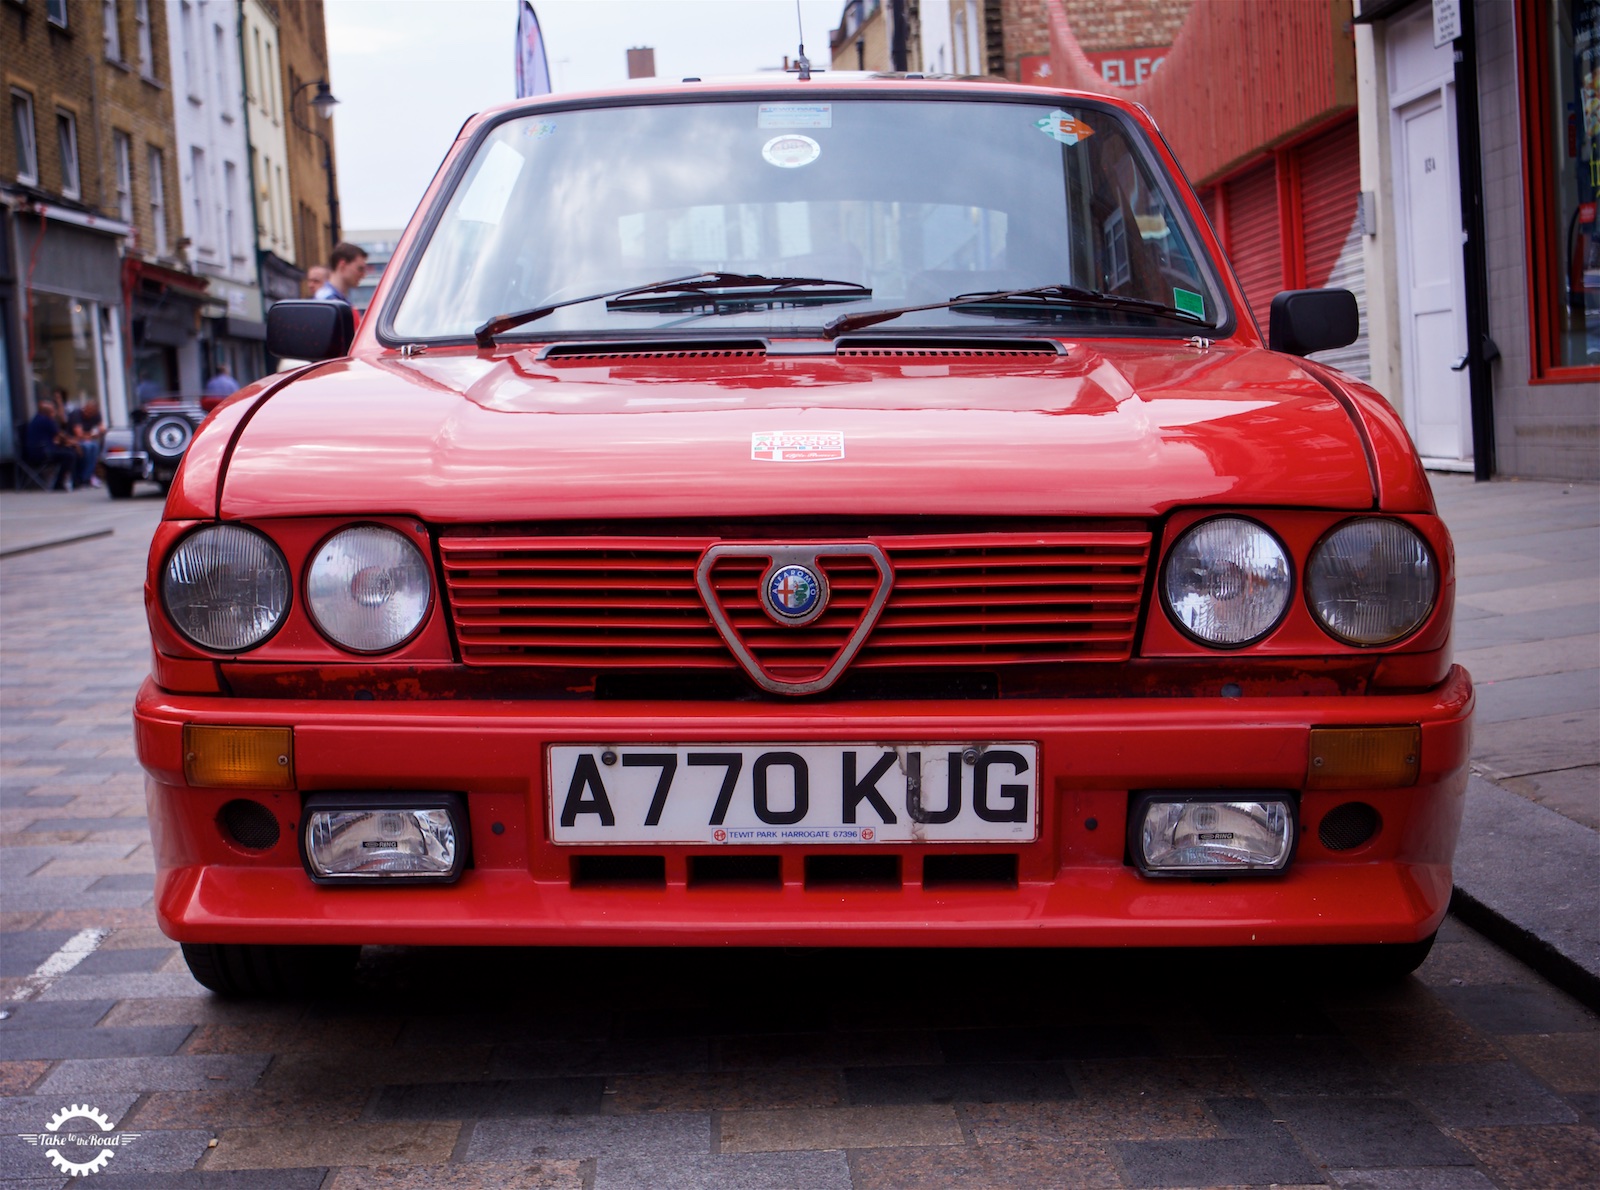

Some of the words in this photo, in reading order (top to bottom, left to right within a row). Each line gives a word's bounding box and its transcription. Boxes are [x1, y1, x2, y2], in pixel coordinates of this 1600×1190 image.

[772, 571, 789, 595] ALFA
[790, 570, 816, 596] ROMEO
[560, 751, 809, 827] A770
[842, 751, 1029, 824] KUG
[833, 830, 857, 838] 67396
